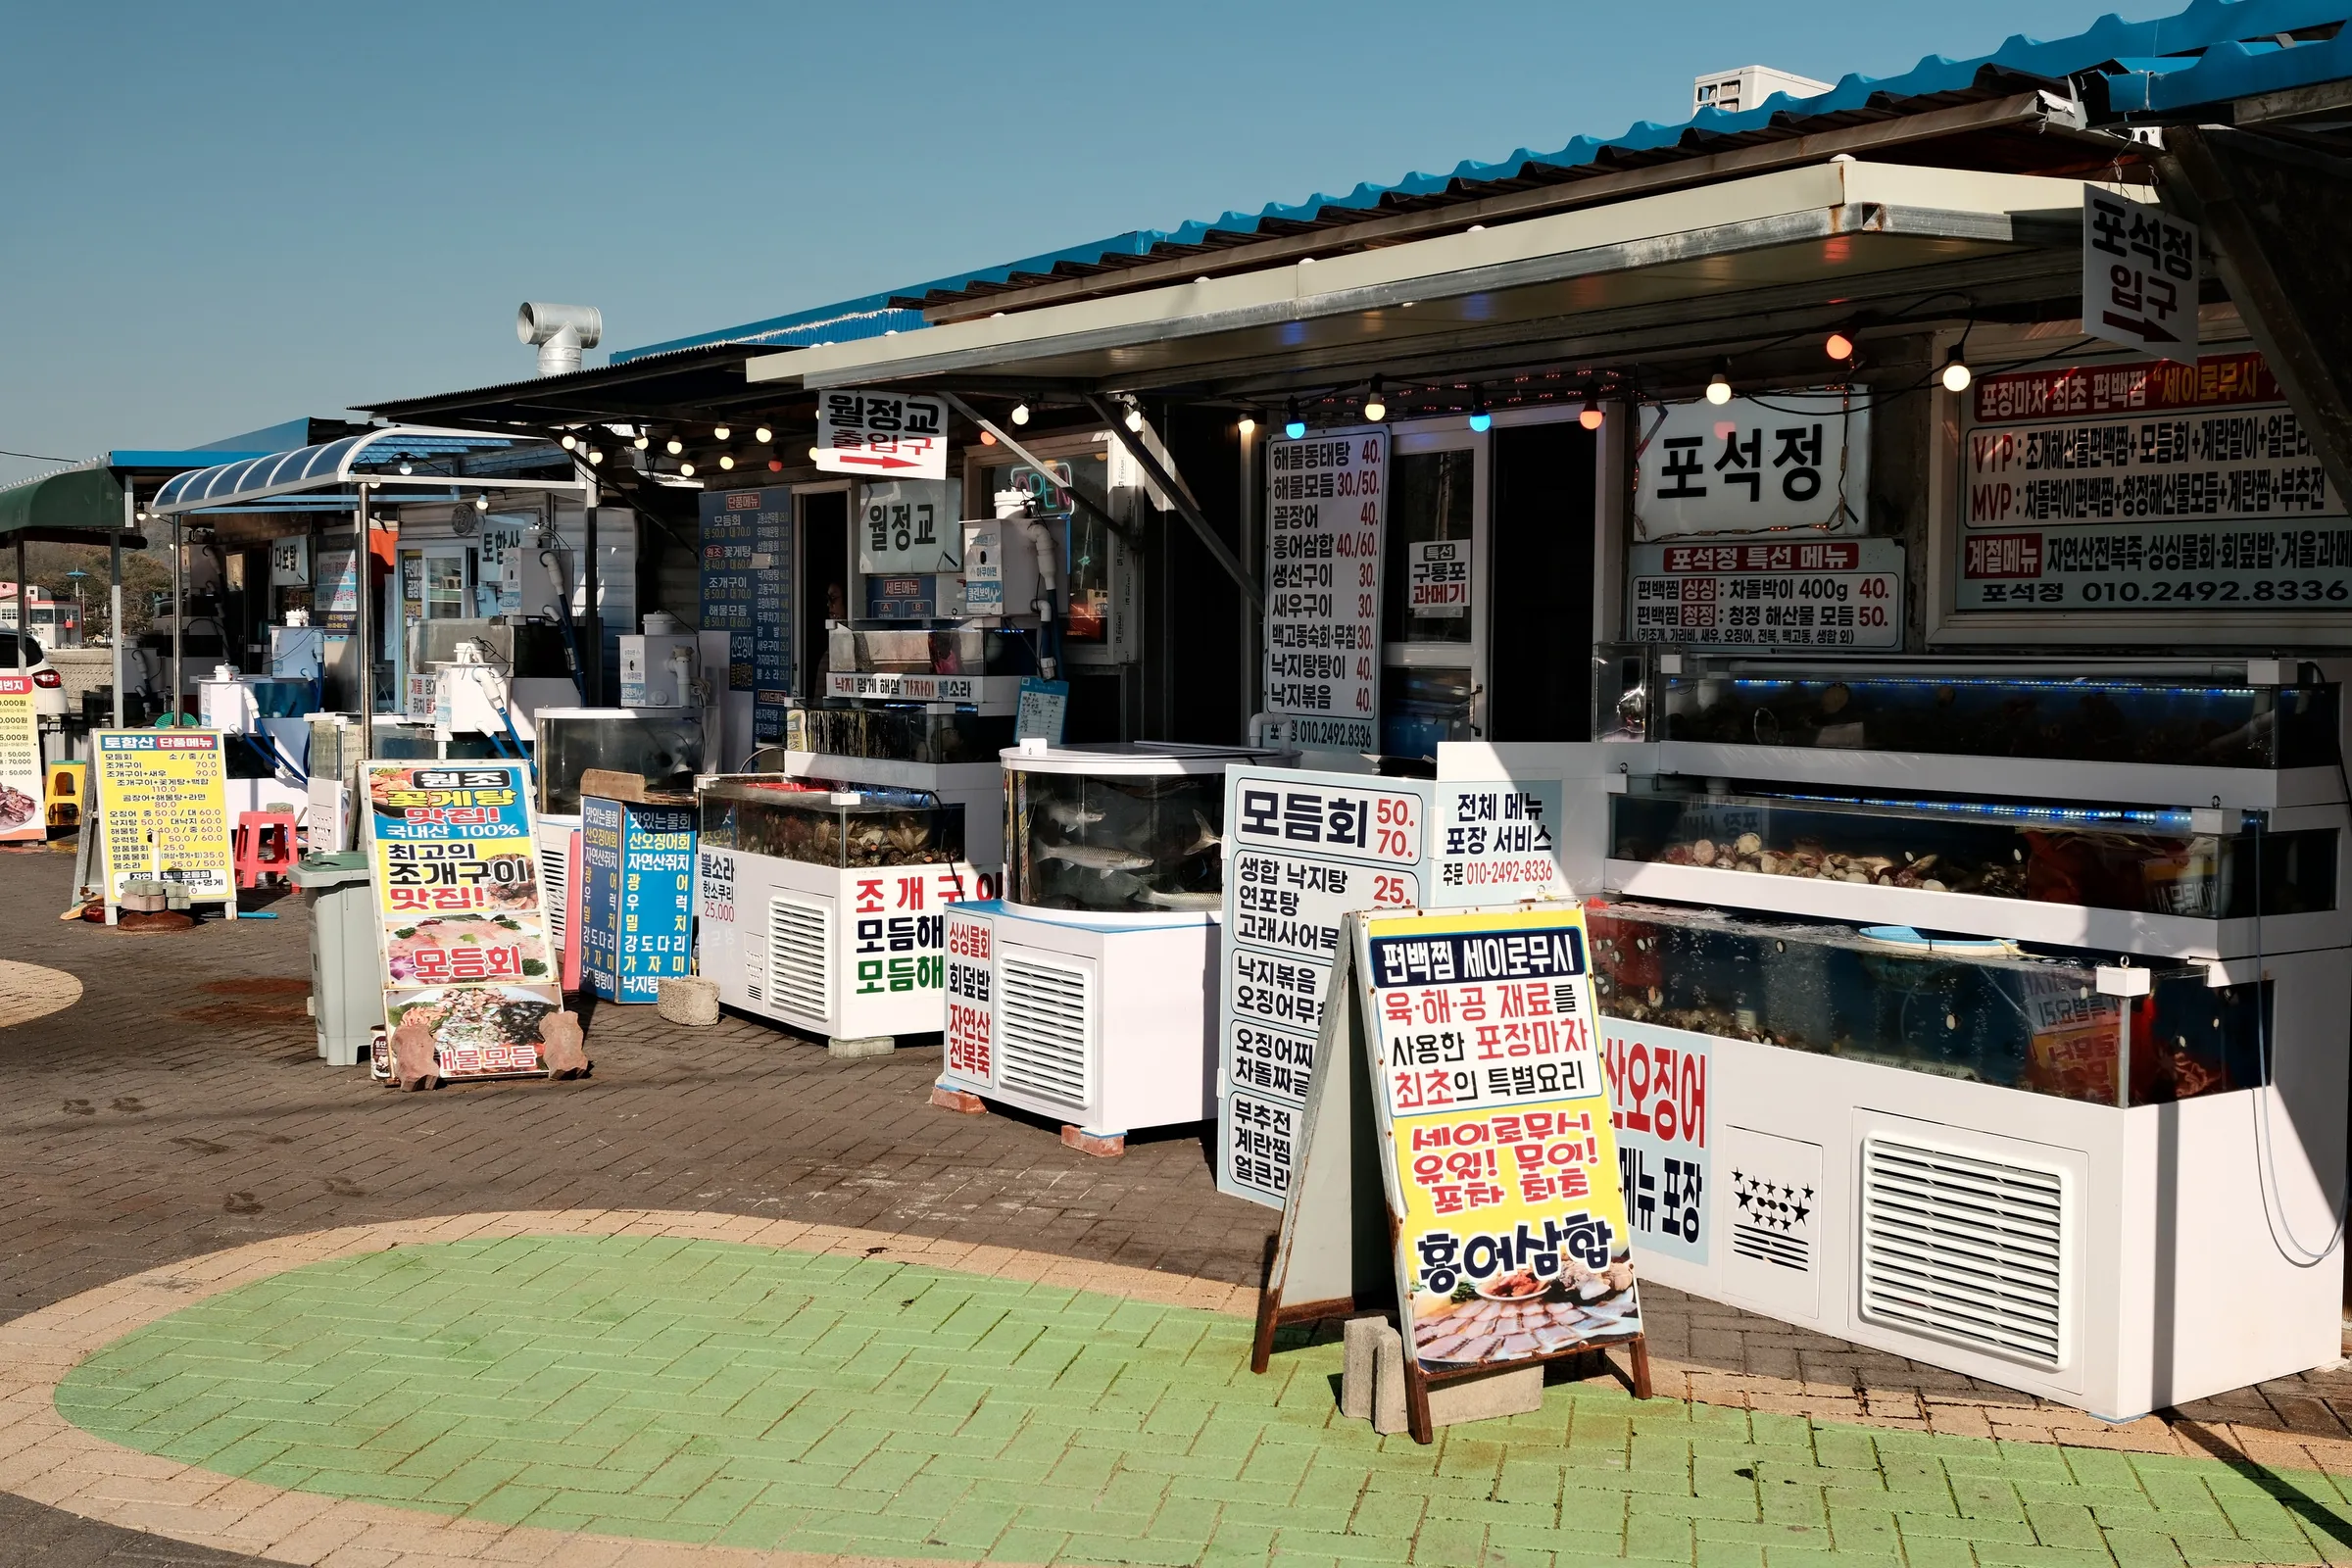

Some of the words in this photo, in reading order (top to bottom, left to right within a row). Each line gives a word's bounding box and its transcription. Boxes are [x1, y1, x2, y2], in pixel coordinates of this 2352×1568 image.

[2091, 198, 2192, 281] 포석정
[2110, 264, 2178, 320] 입구
[1981, 379, 2048, 417] 포장마차
[2052, 374, 2087, 412] 최초
[2093, 369, 2147, 410] 편백찜
[828, 394, 940, 434] 월정교
[831, 428, 934, 456] 출입구
[1273, 441, 1350, 471] 해물동태탕
[1361, 439, 1381, 465] 40.
[1656, 423, 1823, 503] 포석정
[1273, 472, 1334, 500] 해물모듬
[713, 514, 741, 527] 모듬회
[868, 503, 937, 552] 월정교
[1273, 504, 1318, 529] 꼼장어
[1360, 501, 1378, 527] 40.
[1273, 533, 1334, 560] 홍어삼합
[1425, 545, 1454, 561] 특선
[1671, 546, 1738, 571] 포석정
[1746, 545, 1792, 569] 특선
[1799, 544, 1848, 568] 메뉴
[1968, 538, 2038, 574] 계절메뉴
[709, 576, 747, 589] 조개구이
[1272, 564, 1333, 588] 생선구이
[1412, 562, 1466, 583] 구룡포
[1412, 583, 1466, 605] 과메기
[1637, 579, 1680, 601] 편백찜
[1683, 578, 1715, 601] 싱싱
[1729, 578, 1794, 601] 차돌박이
[1798, 578, 1848, 603] 400g
[1859, 577, 1890, 600] 40.
[1982, 582, 2064, 603] 포석정
[2082, 579, 2349, 603] 010.2492.8336
[709, 605, 747, 617] 해물모듬
[1272, 593, 1332, 618] 새우구이
[1637, 606, 1680, 627] 편백찜
[1683, 606, 1715, 626] 청정
[1729, 606, 1760, 627] 청정
[1765, 606, 1815, 627] 해산물
[1820, 605, 1854, 626] 모듬
[1858, 605, 1888, 627] 50.
[1270, 653, 1346, 679] 낙지탕탕이
[834, 677, 854, 693] 낙지
[857, 678, 877, 694] 멍게
[879, 678, 900, 695] 해삼
[1270, 683, 1332, 710] 낙지볶음
[104, 736, 155, 749] 토함산
[159, 737, 213, 748] 단품메뉴
[1300, 720, 1372, 749] 010.2492.8336
[420, 770, 502, 788] 원조
[386, 789, 517, 808] 꽃게탕
[1457, 793, 1497, 822] 전체
[1504, 792, 1544, 821] 메뉴
[386, 824, 451, 838] 국내산
[457, 823, 520, 838] 100%
[405, 808, 500, 826] 맛집!
[585, 807, 618, 829] 맛있는물회
[630, 811, 691, 831] 맛있는물회
[1241, 789, 1369, 849] 모듬회
[1376, 798, 1415, 826] 50.
[388, 843, 475, 860] 최고의
[584, 828, 617, 850] 산오징어회
[628, 832, 691, 851] 산오징어회
[1376, 828, 1413, 858] 70.
[1446, 826, 1488, 855] 포장
[1494, 824, 1552, 854] 서비스
[388, 859, 528, 886] 조개구이
[584, 847, 617, 870] 자연산쥐치
[627, 854, 689, 872] 자연산쥐치
[701, 853, 734, 882] 뿔소라
[1443, 862, 1463, 886] 주문
[1466, 858, 1553, 885] 010-2492-8336
[703, 881, 734, 905] 한소쿠리
[1240, 857, 1281, 886] 생합
[1286, 862, 1348, 894] 낙지탕
[1373, 875, 1411, 906] 25.
[389, 886, 485, 911] 맛집!
[704, 901, 735, 923] 25,000
[1239, 884, 1299, 917] 연포탕
[949, 921, 991, 961] 싱싱물회
[414, 945, 524, 979] 모듬회
[1383, 940, 1456, 984] 편백찜
[1462, 934, 1575, 979] 세이로무시
[949, 962, 991, 1002] 회덮밥
[1237, 956, 1316, 995] 낙지볶음
[1237, 985, 1323, 1026] 오징어무
[1496, 982, 1577, 1019] 재료를
[949, 1003, 991, 1044] 자연산
[1392, 1031, 1465, 1067] 사용한
[1475, 1017, 1588, 1060] 포장마차
[949, 1036, 991, 1079] 전복죽
[1395, 1068, 1479, 1109] 최초의
[1488, 1060, 1585, 1098] 특별요리
[1234, 1099, 1291, 1138] 부추전
[1412, 1111, 1592, 1152] 세이로무시
[1234, 1127, 1291, 1166] 계란찜
[1413, 1148, 1498, 1186] 유일!
[1514, 1137, 1598, 1172] 무이!
[1431, 1183, 1505, 1214] 포차
[1520, 1168, 1589, 1202] 최초
[1662, 1156, 1702, 1244] 포장
[1417, 1212, 1613, 1294] 홍어삼합
